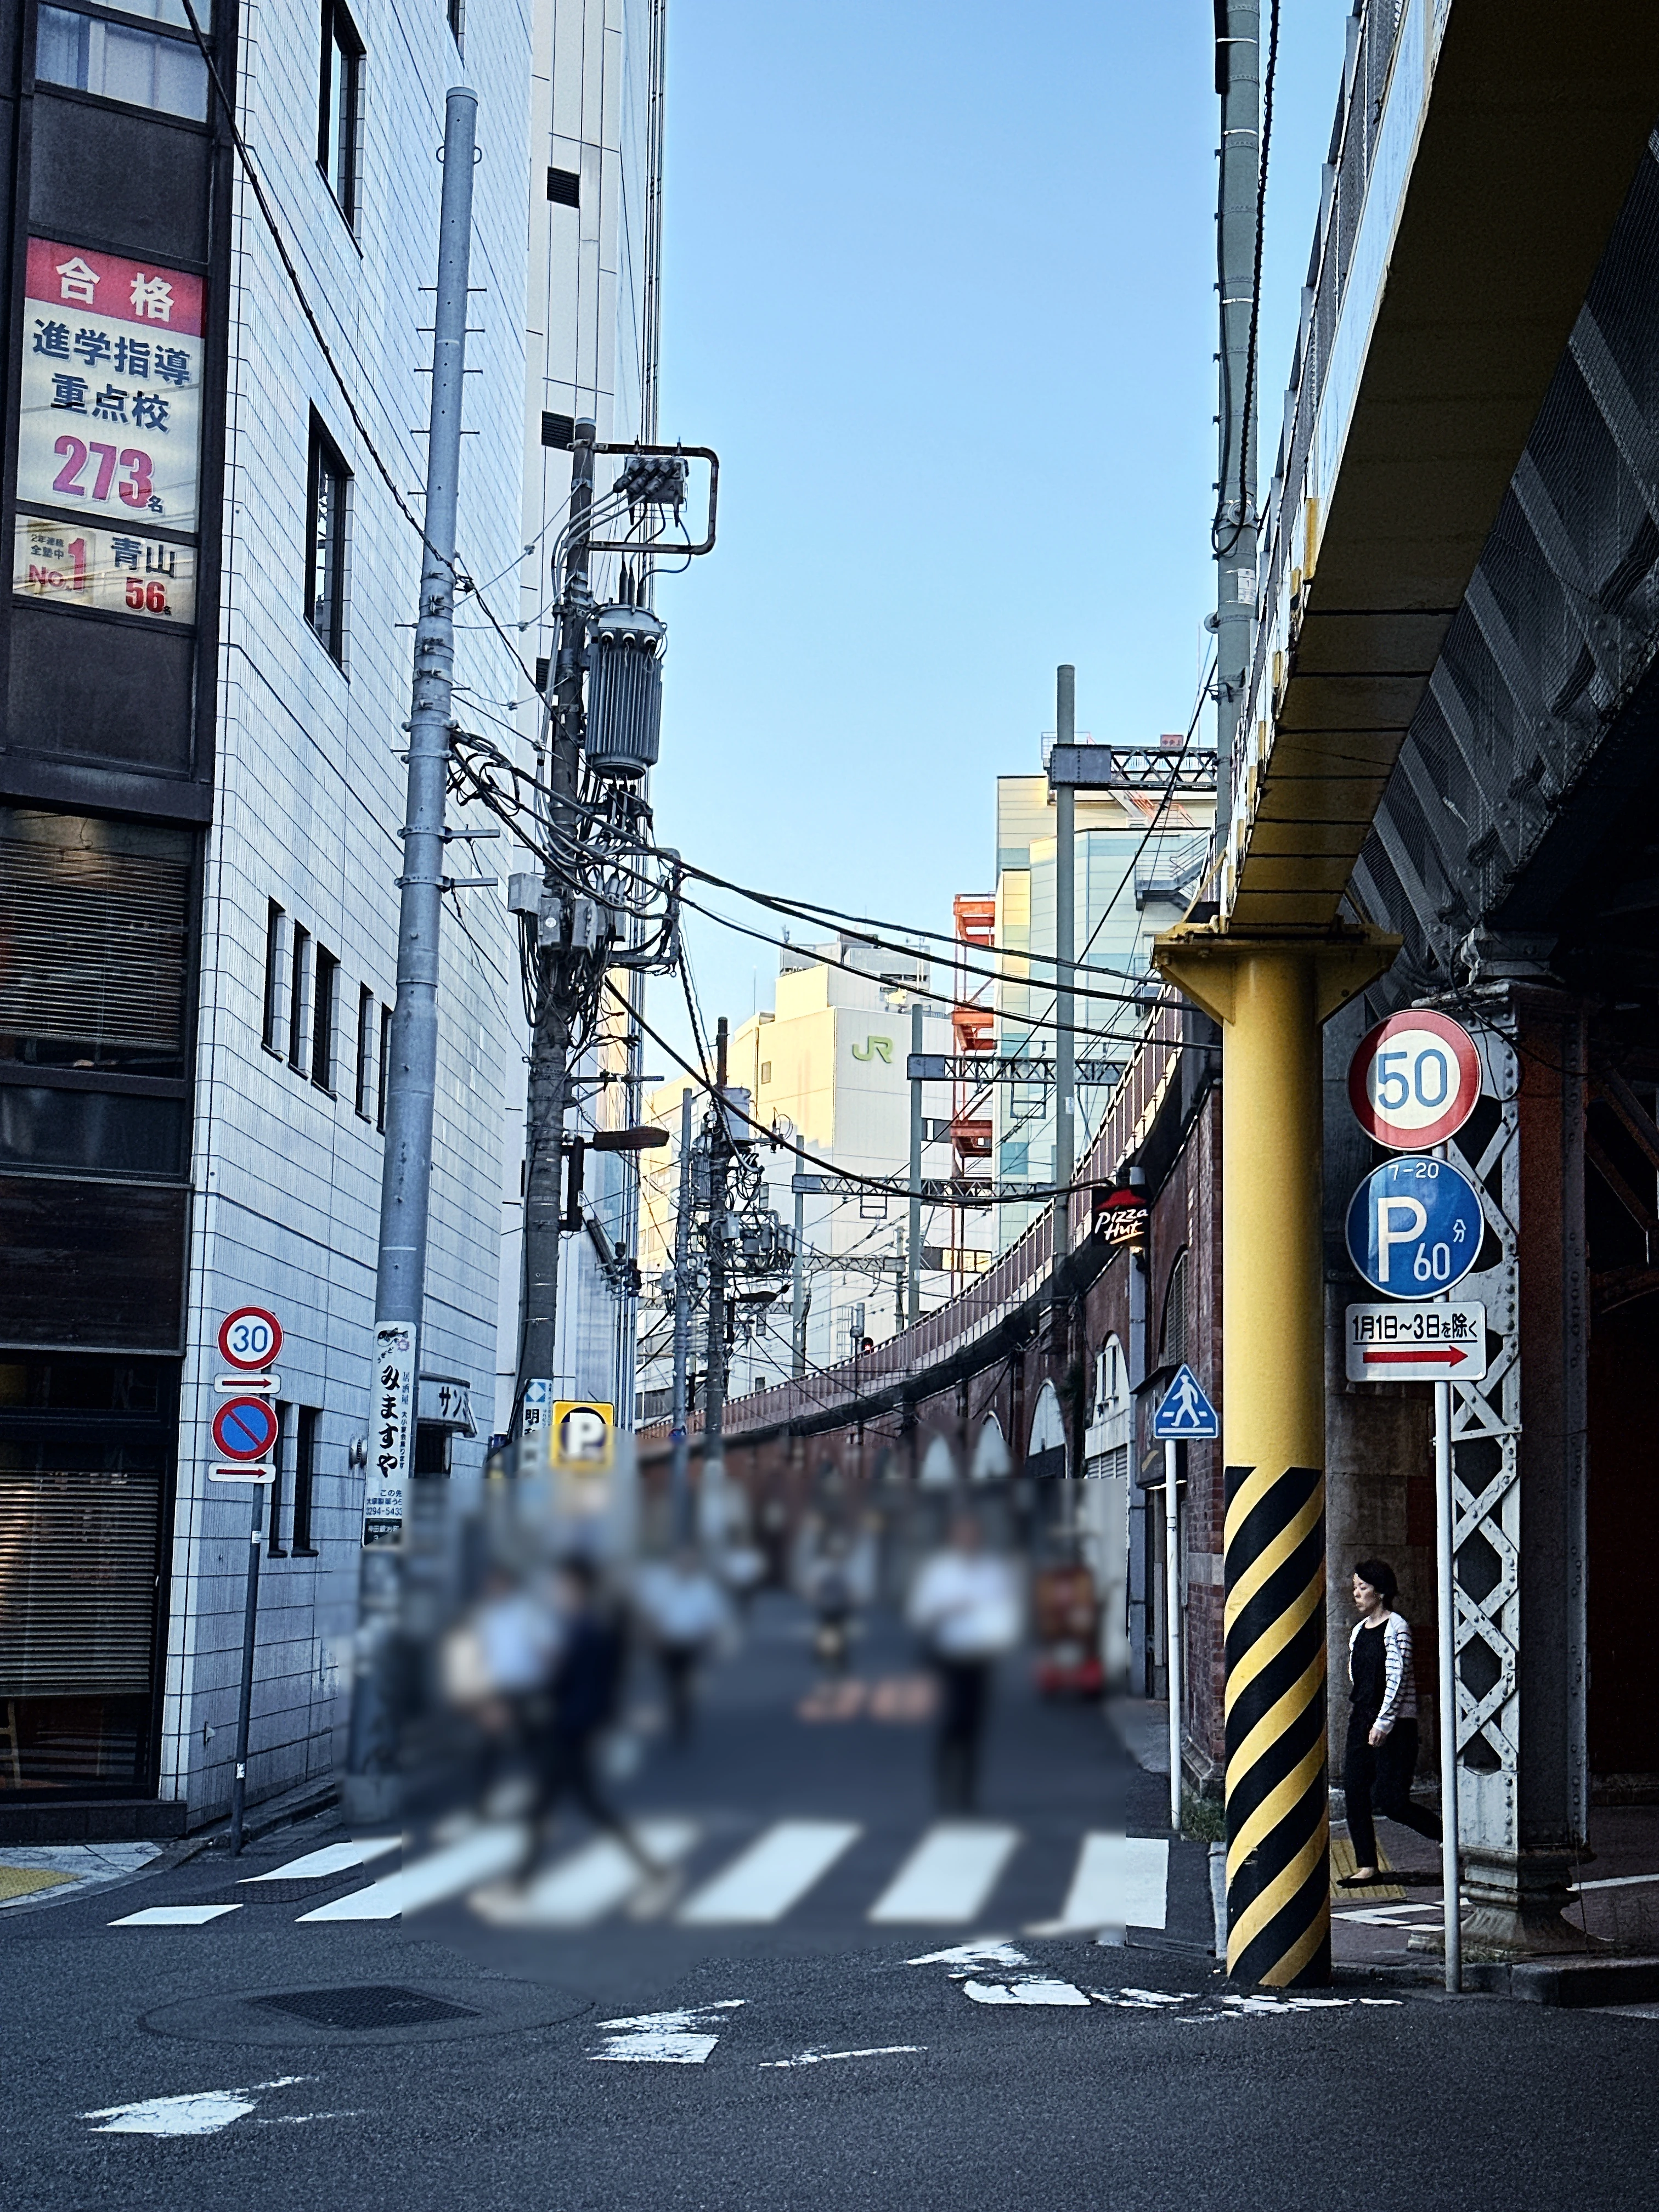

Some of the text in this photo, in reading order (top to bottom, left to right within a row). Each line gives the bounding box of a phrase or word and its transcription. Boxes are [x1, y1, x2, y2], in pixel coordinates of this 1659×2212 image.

[56, 257, 174, 323] 合格
[32, 319, 191, 386] 進学指導
[50, 373, 171, 434] 重点校
[111, 537, 176, 578] 青山
[853, 1035, 893, 1063] JR
[1378, 1048, 1448, 1110] 50
[1388, 1162, 1440, 1181] 7-20
[1094, 1209, 1149, 1234] Pizza
[1104, 1220, 1144, 1241] Hut
[1378, 1196, 1427, 1283] P
[1453, 1218, 1467, 1243] 分
[1413, 1242, 1451, 1282] 60
[233, 1324, 268, 1353] 30
[376, 1364, 400, 1478] みますや
